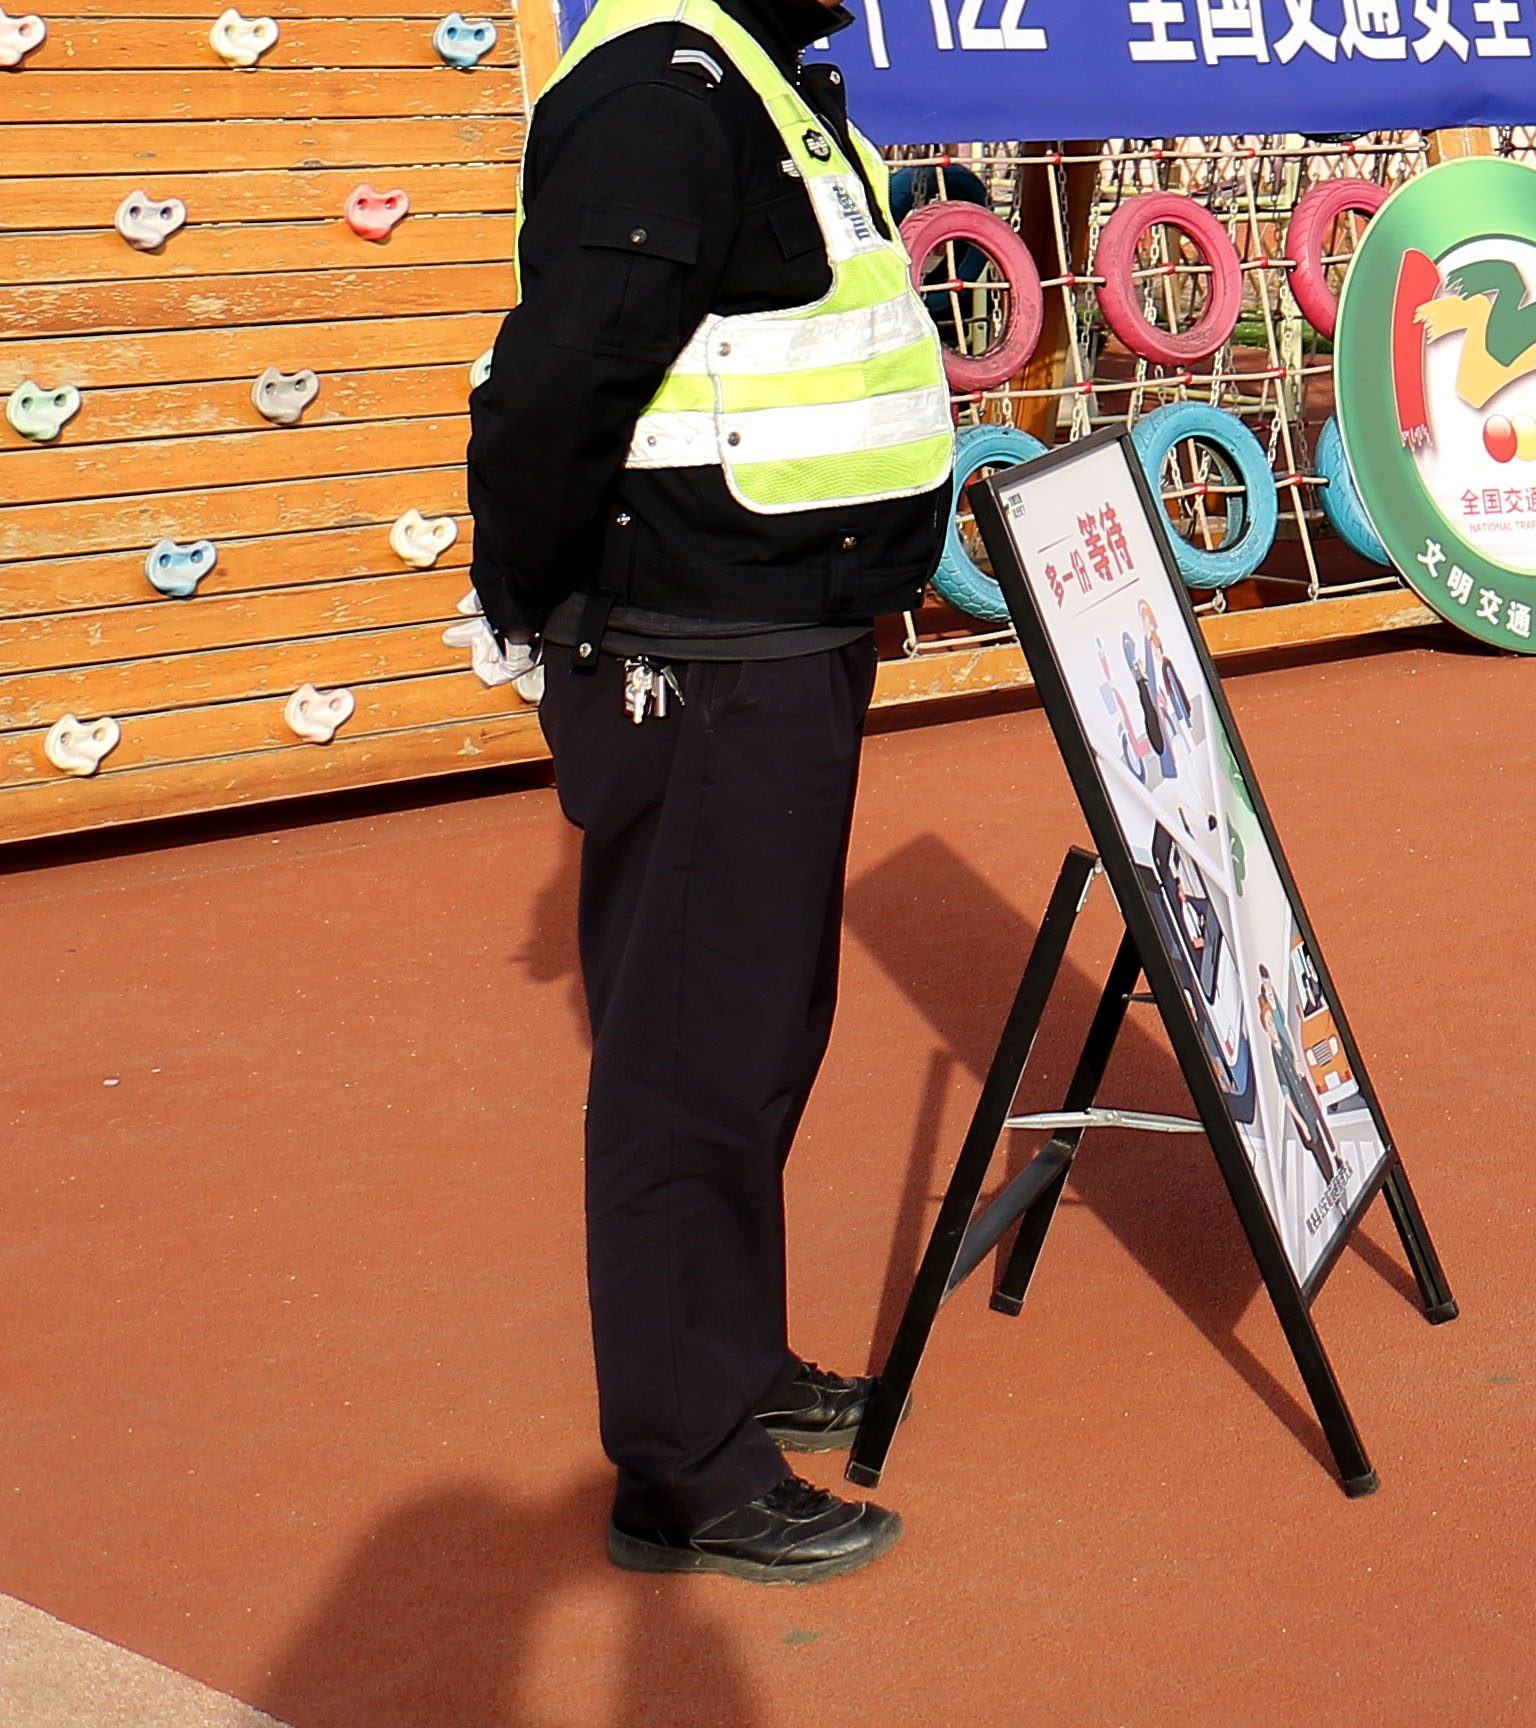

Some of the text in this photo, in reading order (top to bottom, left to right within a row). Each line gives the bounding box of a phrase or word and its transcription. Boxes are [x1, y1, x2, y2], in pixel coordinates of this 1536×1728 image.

[1044, 501, 1135, 609] 多一份等待
[1469, 521, 1513, 533] NATIONAL
[1417, 538, 1532, 638] 文明交通
